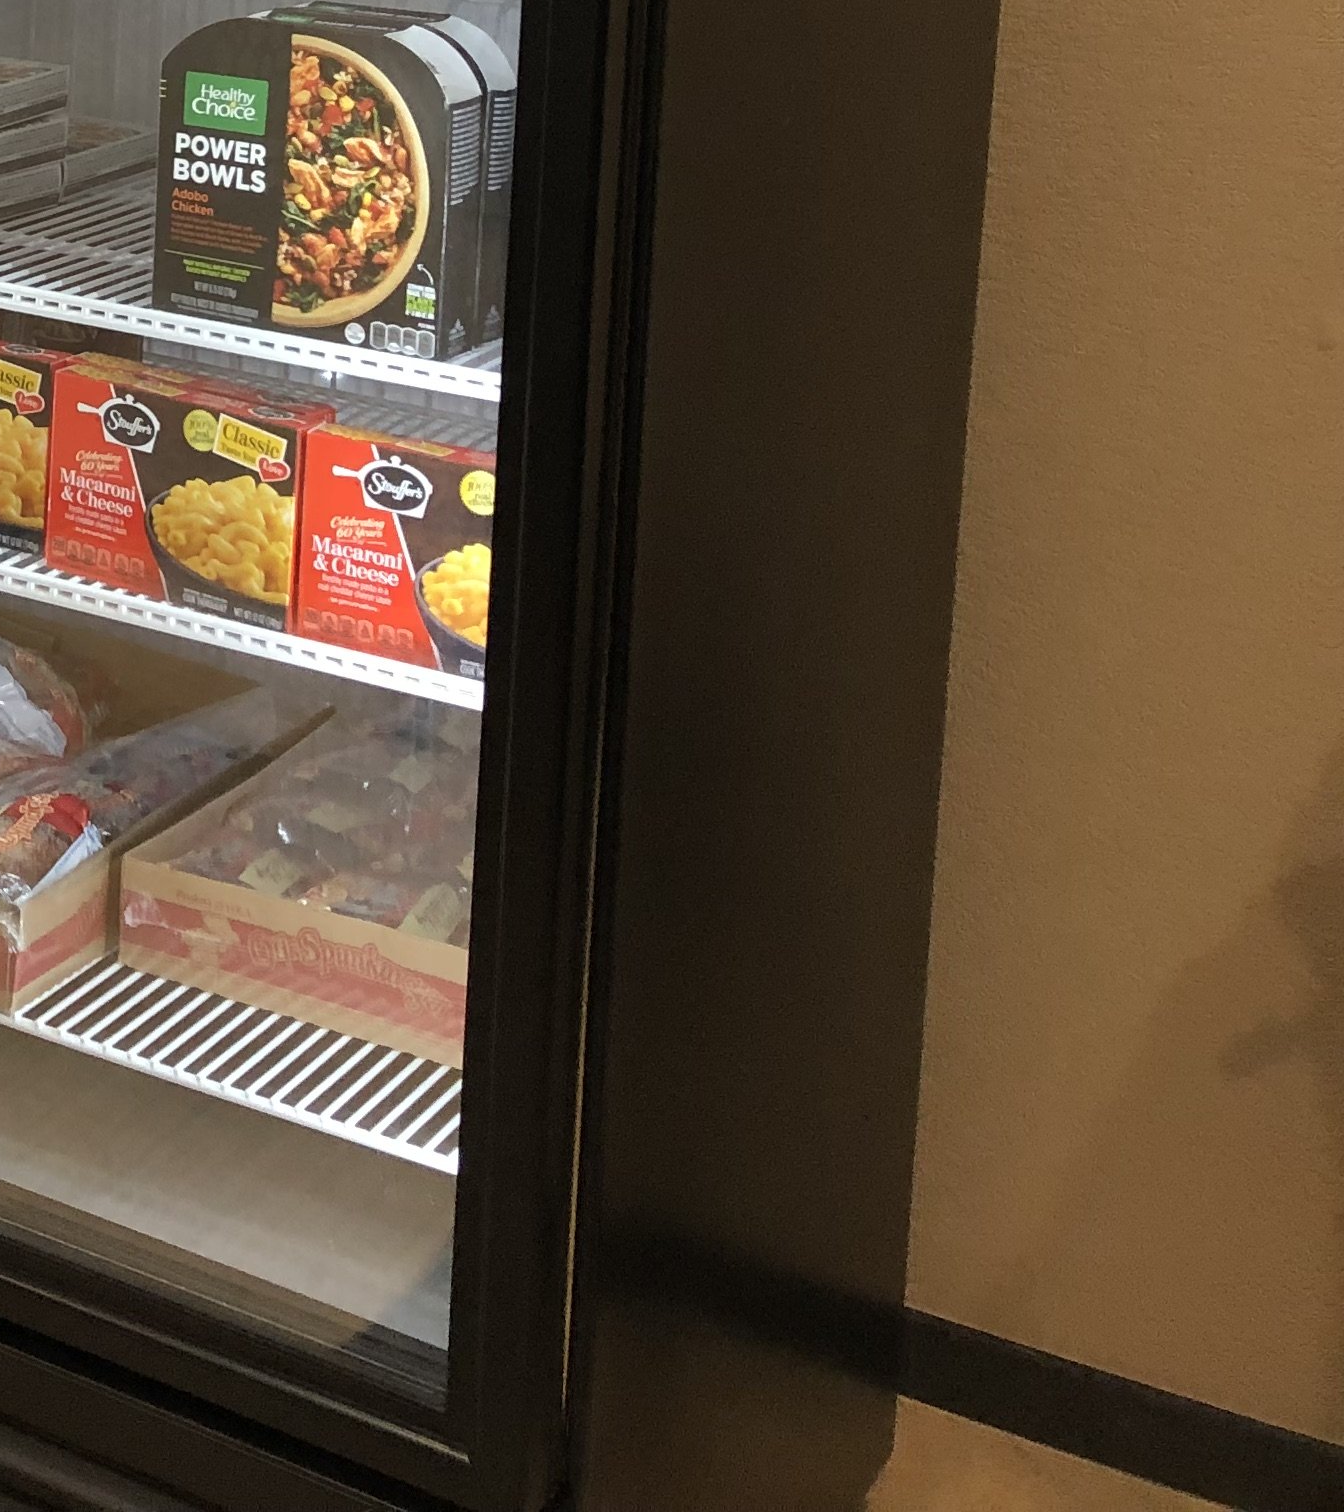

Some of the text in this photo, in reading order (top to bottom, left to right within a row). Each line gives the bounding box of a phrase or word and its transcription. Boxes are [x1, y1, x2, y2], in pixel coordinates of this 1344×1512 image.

[192, 97, 257, 121] Choice
[200, 83, 255, 106] Healthy
[175, 132, 266, 166] POWER
[173, 157, 266, 193] BOWLS
[172, 187, 209, 203] Adobo
[172, 200, 214, 216] Chicken
[107, 409, 152, 437] Stouffer's
[223, 422, 280, 459] Classic
[60, 466, 136, 502] Macaroni
[367, 472, 423, 501] Stouffer's
[61, 485, 133, 517] & Cheese
[330, 515, 385, 529] Celebrating
[336, 527, 383, 540] 60 Years
[312, 534, 403, 570] Macaroni
[313, 554, 399, 586] & Cheese
